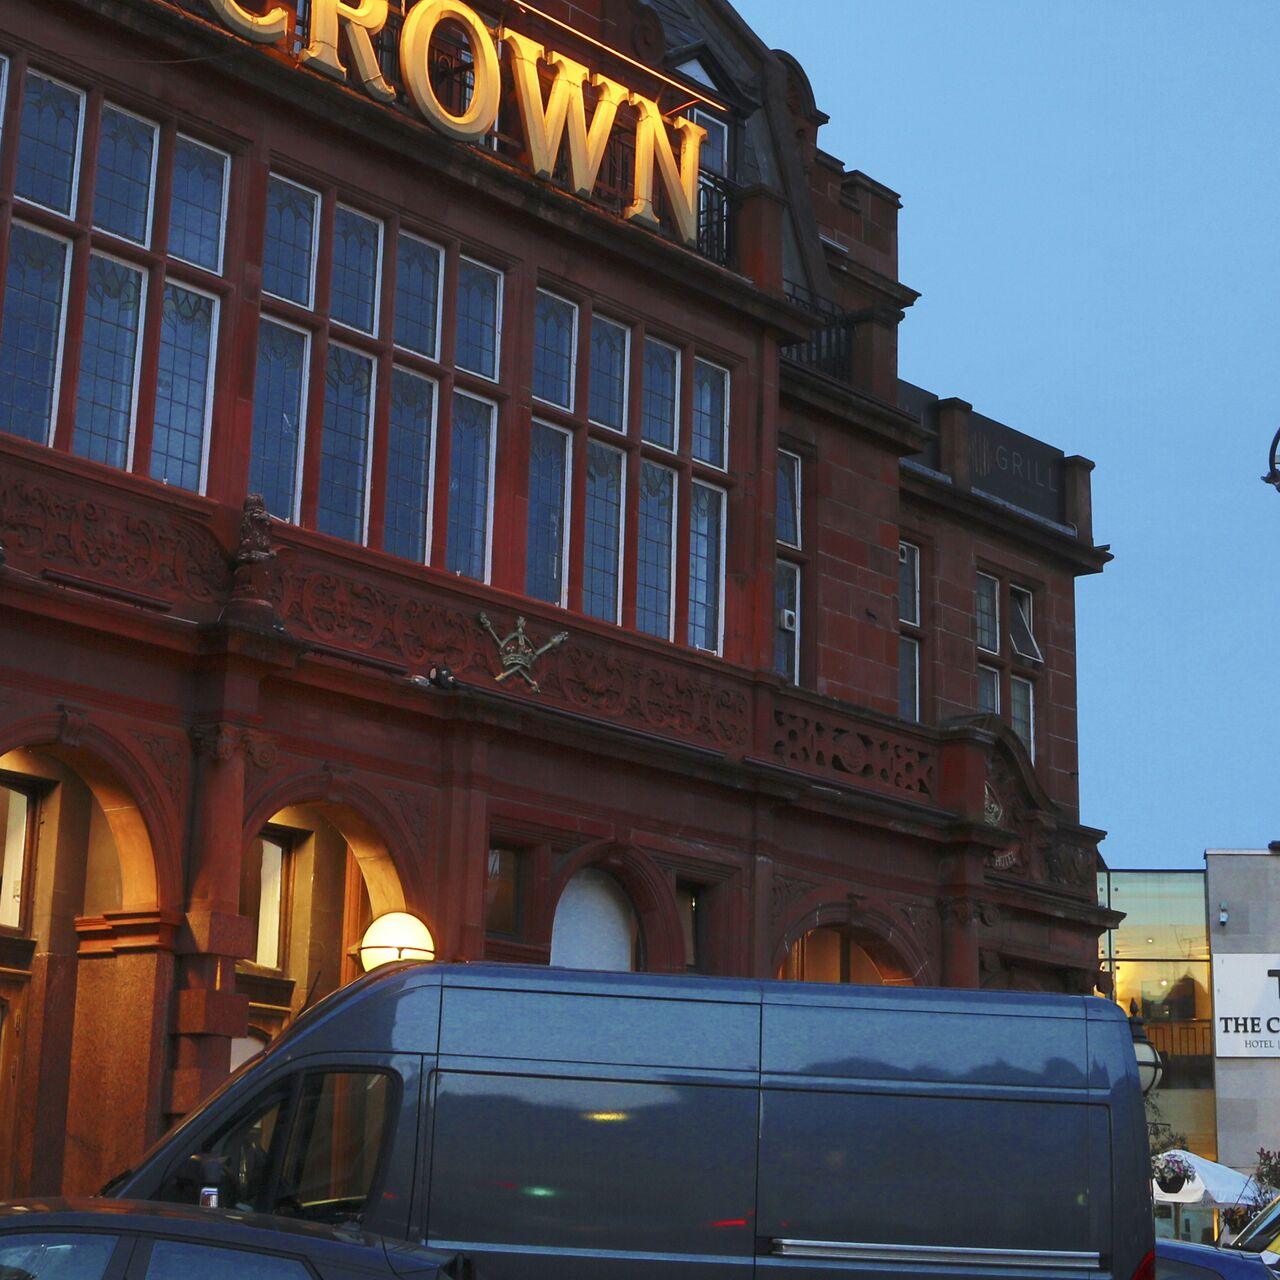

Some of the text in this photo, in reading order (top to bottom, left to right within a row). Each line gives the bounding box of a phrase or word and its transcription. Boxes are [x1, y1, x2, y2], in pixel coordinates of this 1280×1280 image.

[995, 446, 1058, 492] GRILL
[1219, 1017, 1262, 1034] THE
[1245, 1040, 1274, 1048] HOTEL
